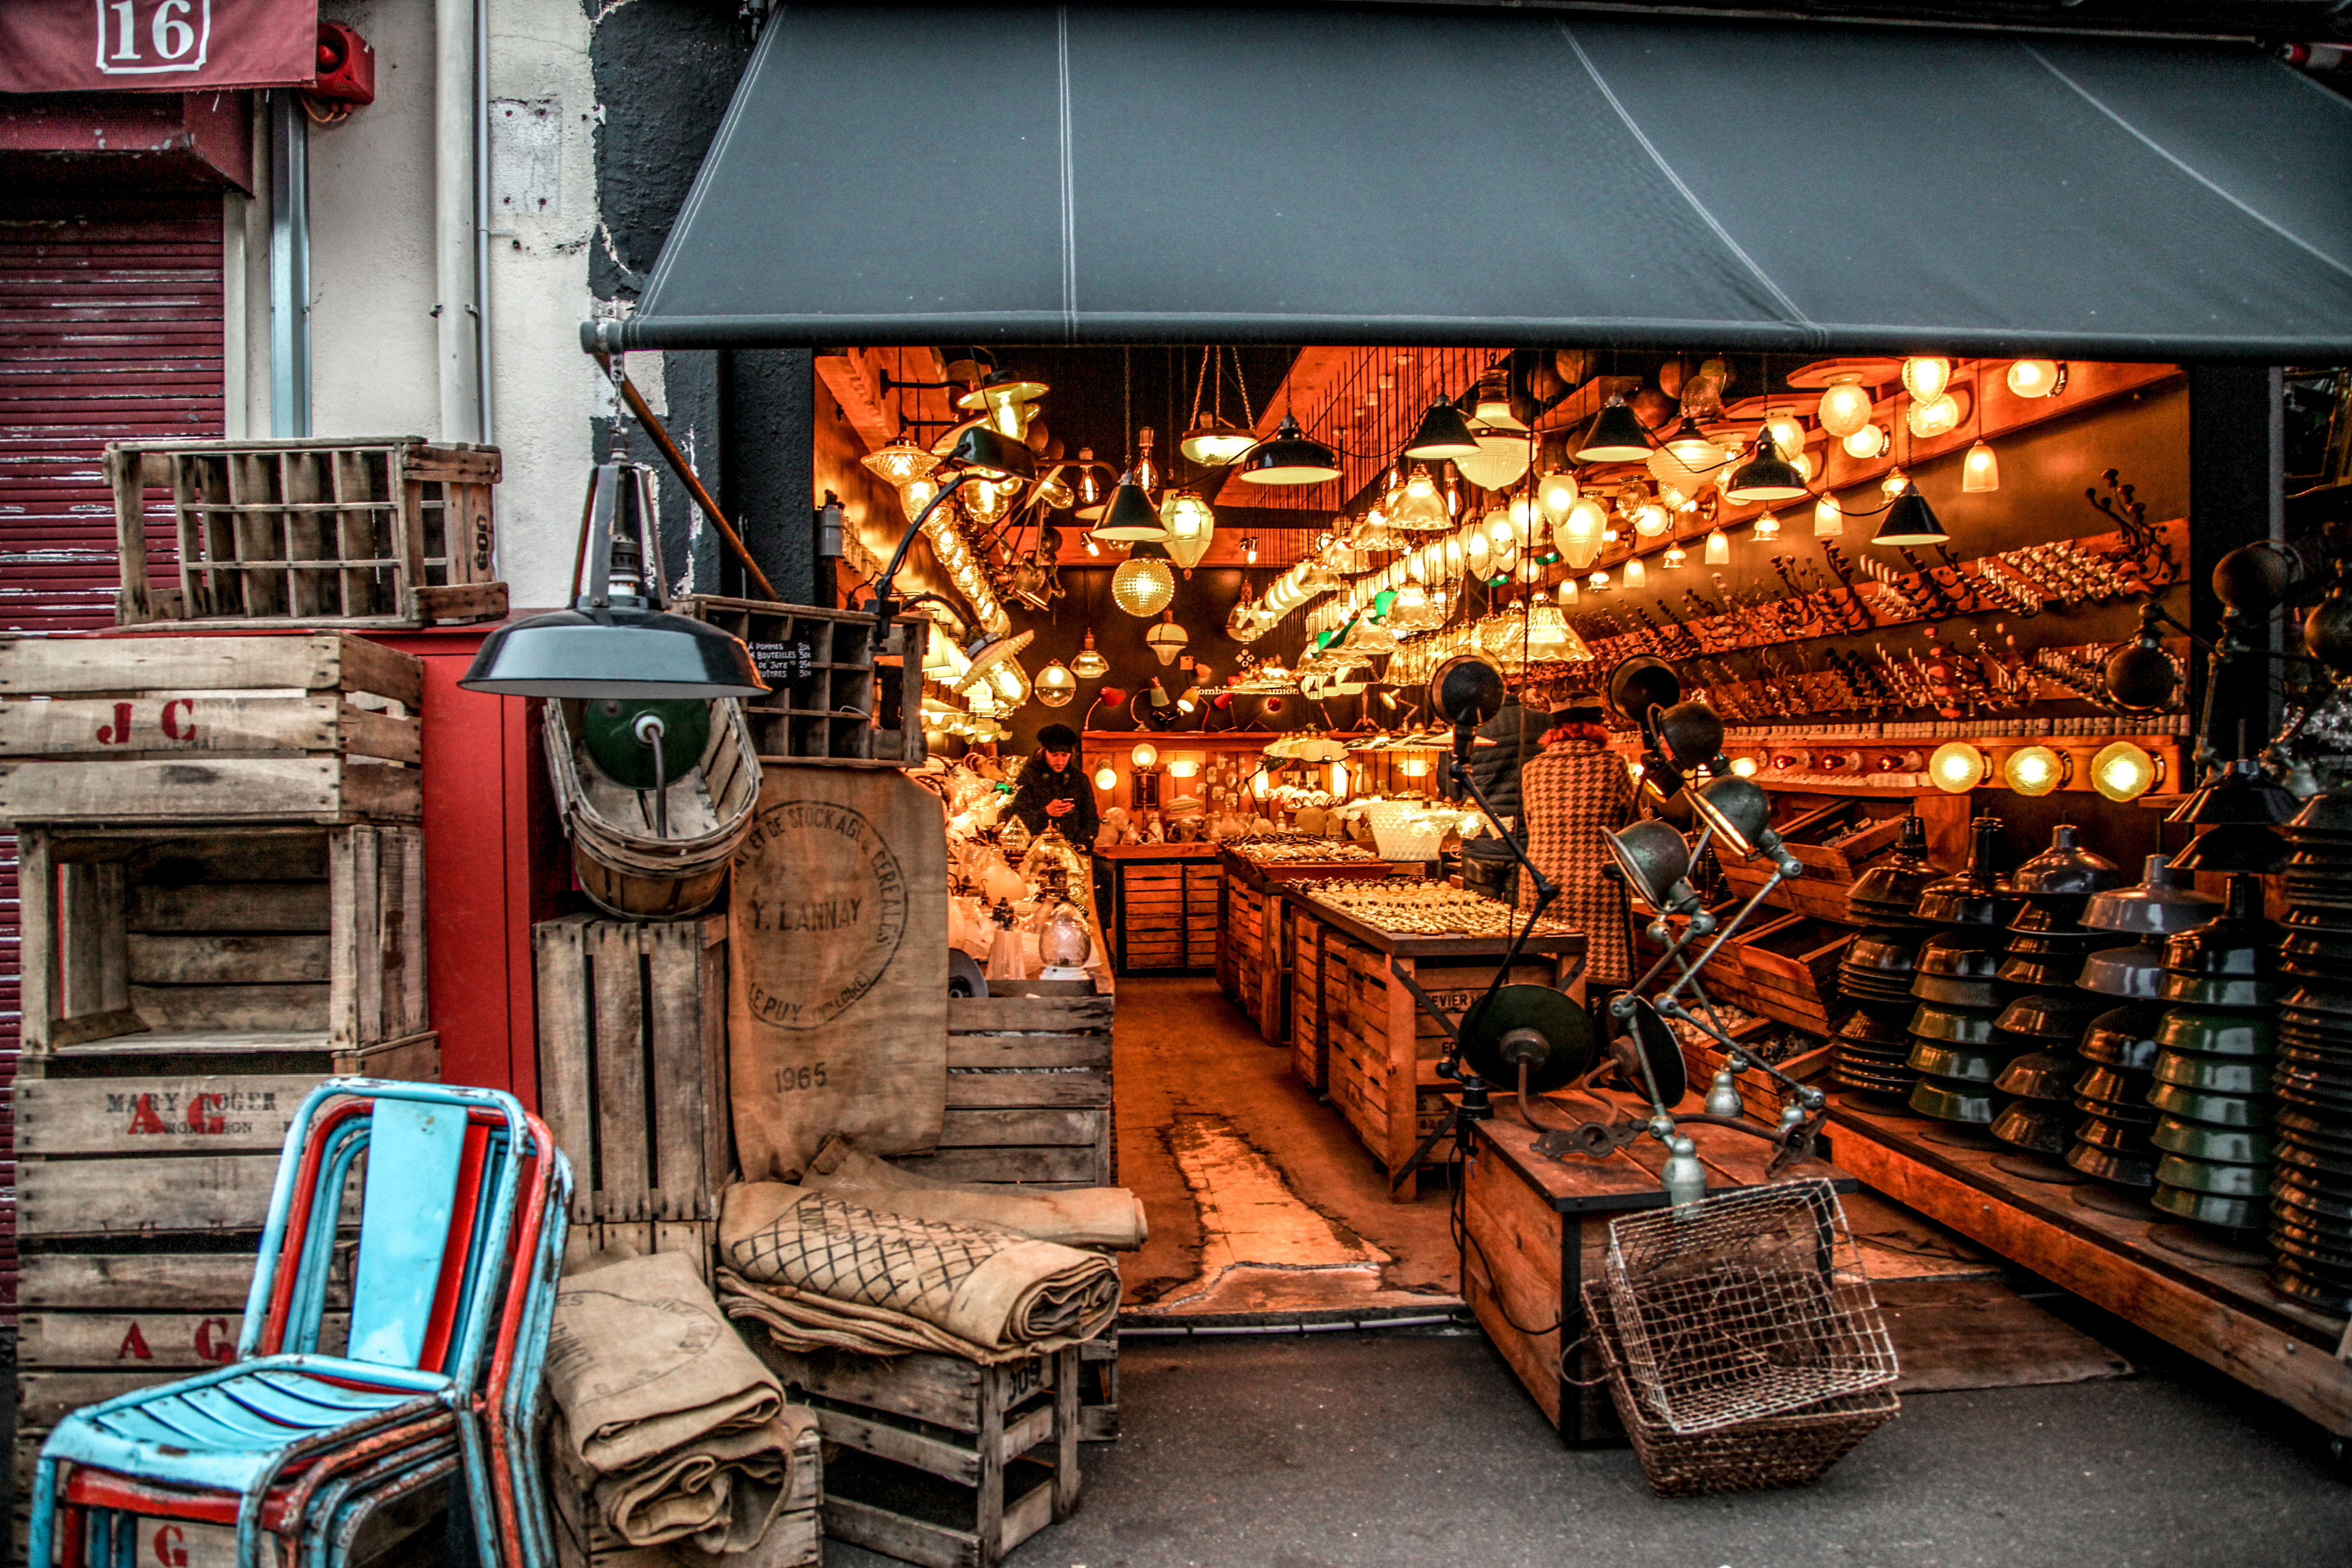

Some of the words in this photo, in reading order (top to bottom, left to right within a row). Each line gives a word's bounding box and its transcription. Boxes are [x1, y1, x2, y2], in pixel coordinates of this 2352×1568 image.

[111, 0, 194, 59] 16
[757, 651, 796, 660] BOUTEILLES
[770, 661, 788, 669] JUTE
[1266, 685, 1300, 695] amion
[96, 702, 133, 745] J
[160, 699, 196, 740] C
[766, 816, 785, 838] DE
[870, 850, 901, 945] CEREALES
[762, 996, 802, 1022] PUY
[775, 1062, 828, 1093] 1965
[118, 1320, 153, 1359] A
[195, 1317, 237, 1364] G
[153, 1524, 190, 1568] G
